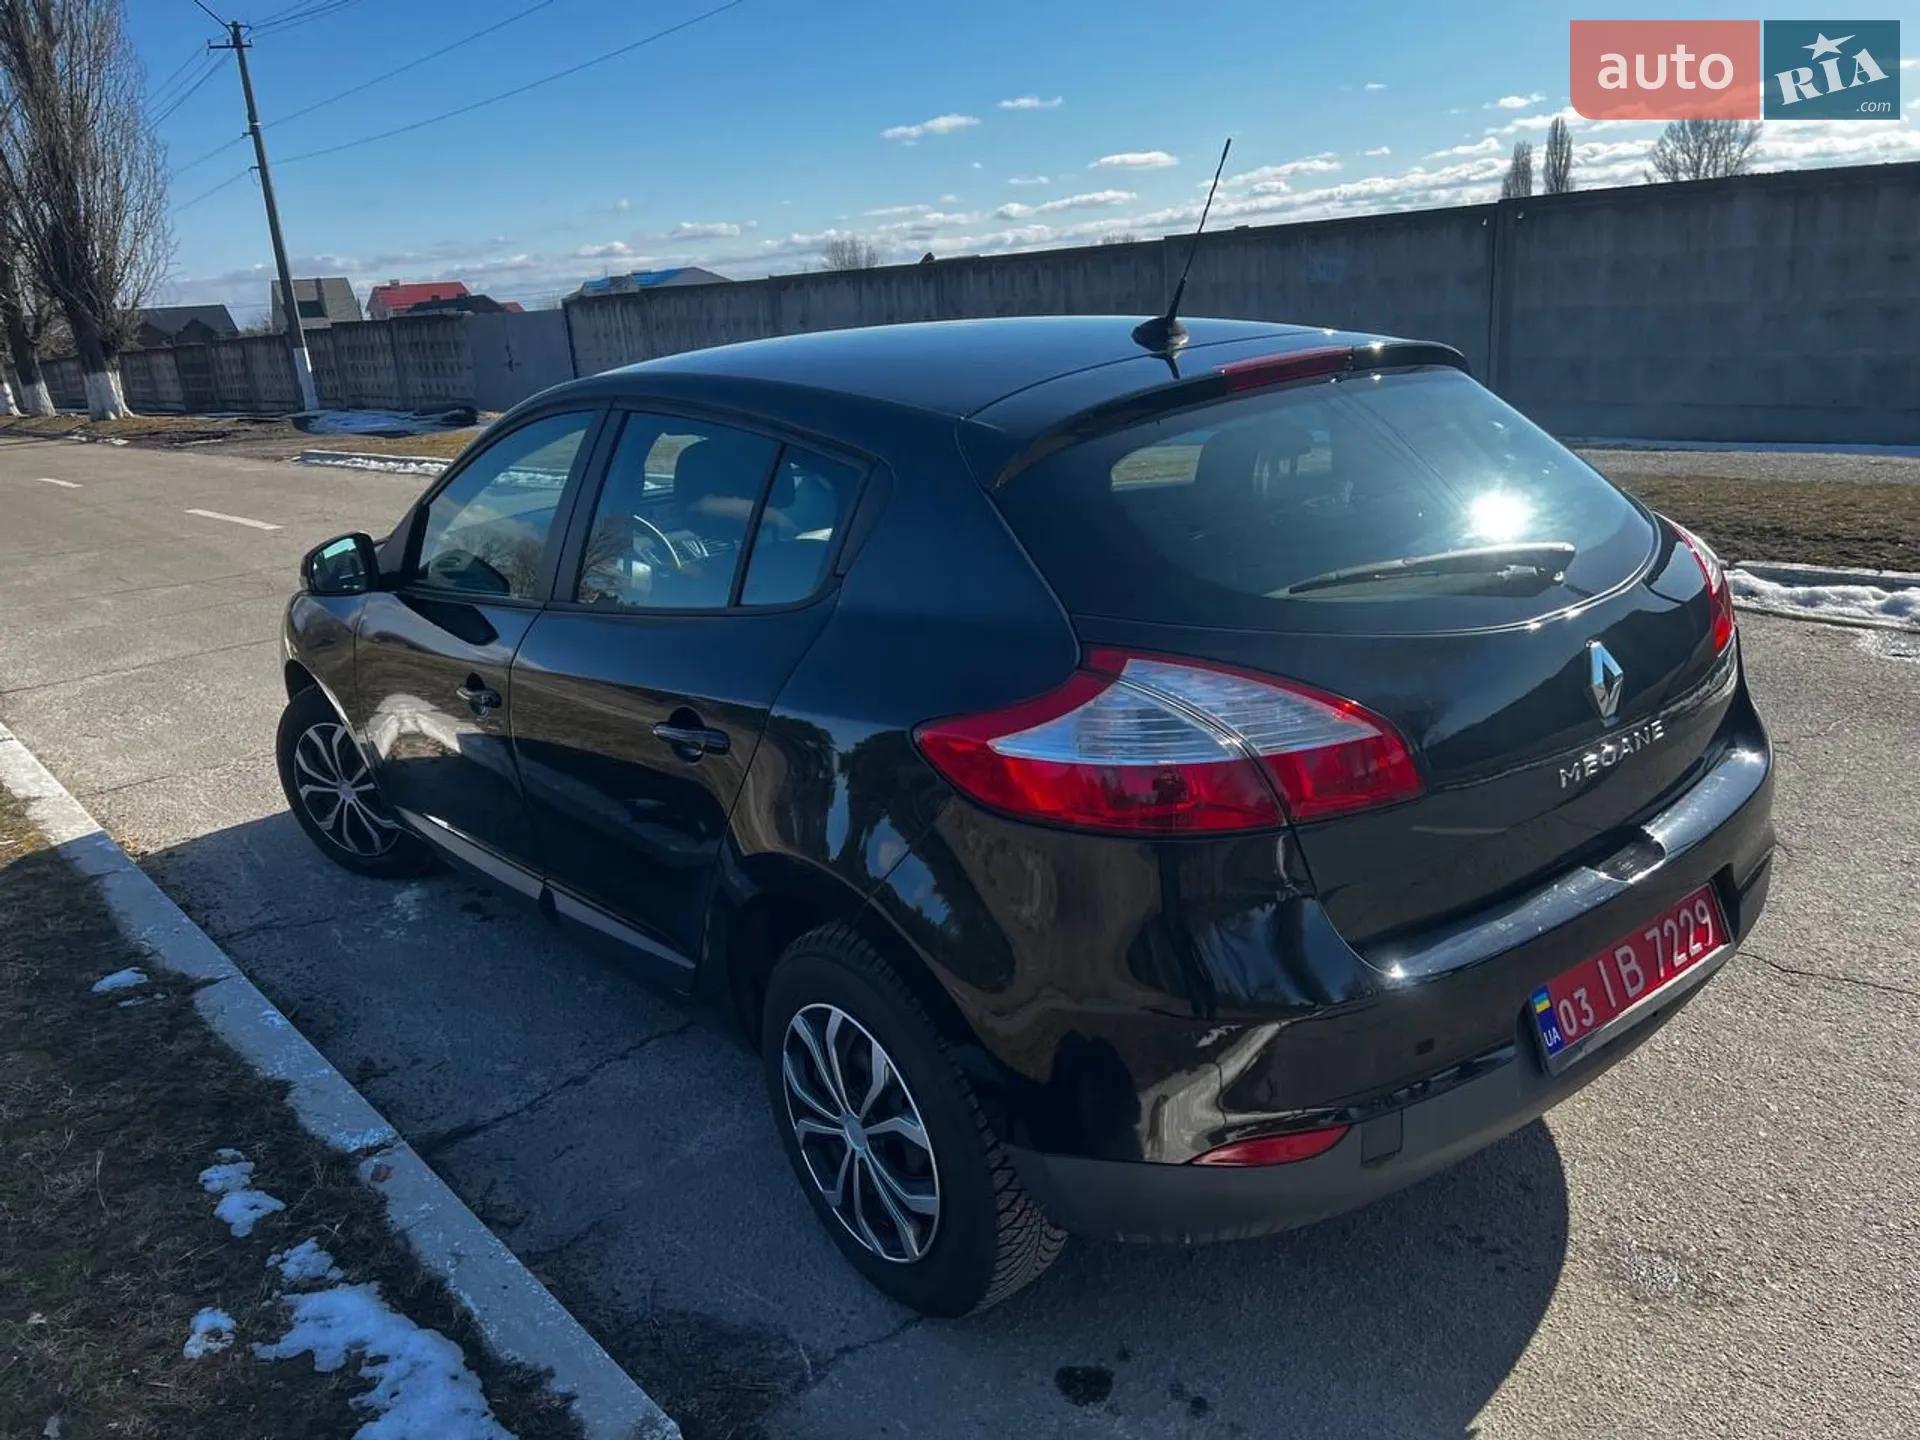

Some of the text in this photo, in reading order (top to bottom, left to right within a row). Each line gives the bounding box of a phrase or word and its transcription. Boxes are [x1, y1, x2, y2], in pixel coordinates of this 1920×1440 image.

[1558, 899, 1713, 1037] 03 IB 7229
[1544, 1026, 1561, 1047] UA
